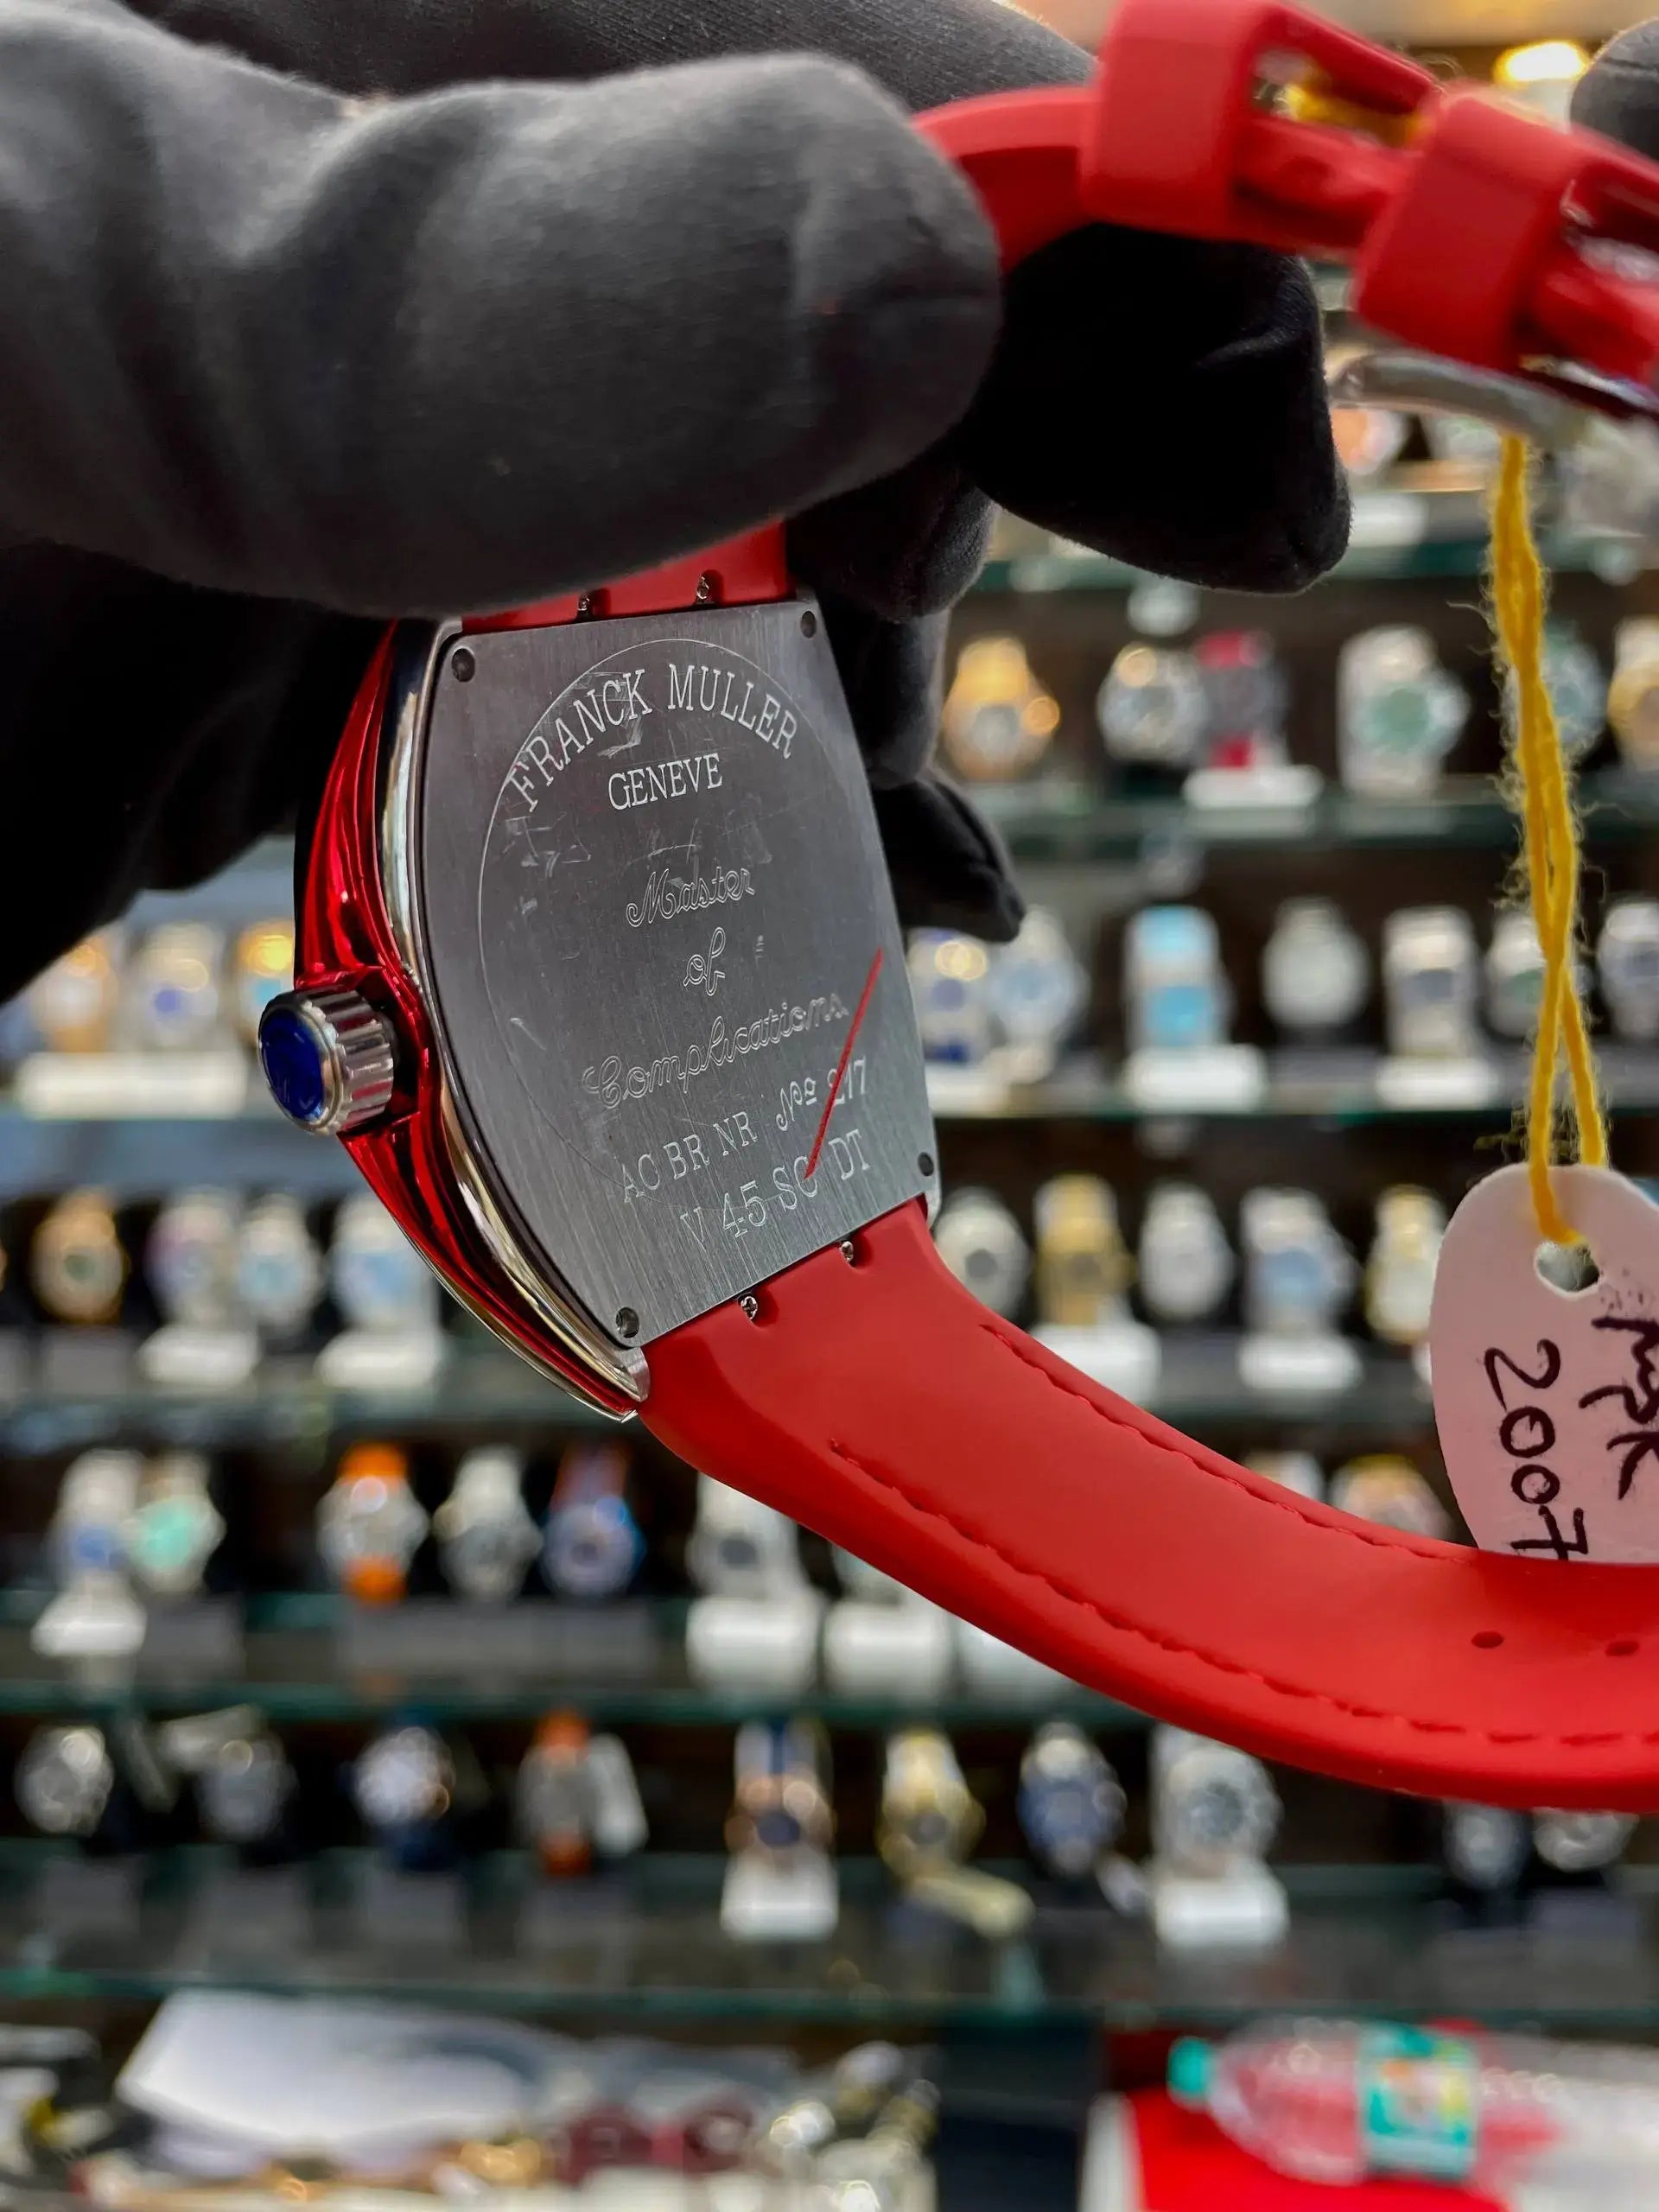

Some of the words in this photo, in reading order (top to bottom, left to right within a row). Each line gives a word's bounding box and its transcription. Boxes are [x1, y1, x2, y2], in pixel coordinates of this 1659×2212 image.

[507, 668, 652, 813] FRANCK
[667, 663, 798, 760] MULLER
[607, 753, 723, 810] GENEVE
[625, 866, 757, 928] Master
[683, 926, 727, 996] of
[582, 992, 850, 1109] Complications
[663, 1135, 710, 1180] BR
[713, 1110, 758, 1156] NR
[680, 1208, 707, 1252] V
[721, 1180, 767, 1238] 45
[773, 1154, 818, 1211] SC
[829, 1128, 871, 1182] DT
[1482, 1338, 1590, 1561] 2007
